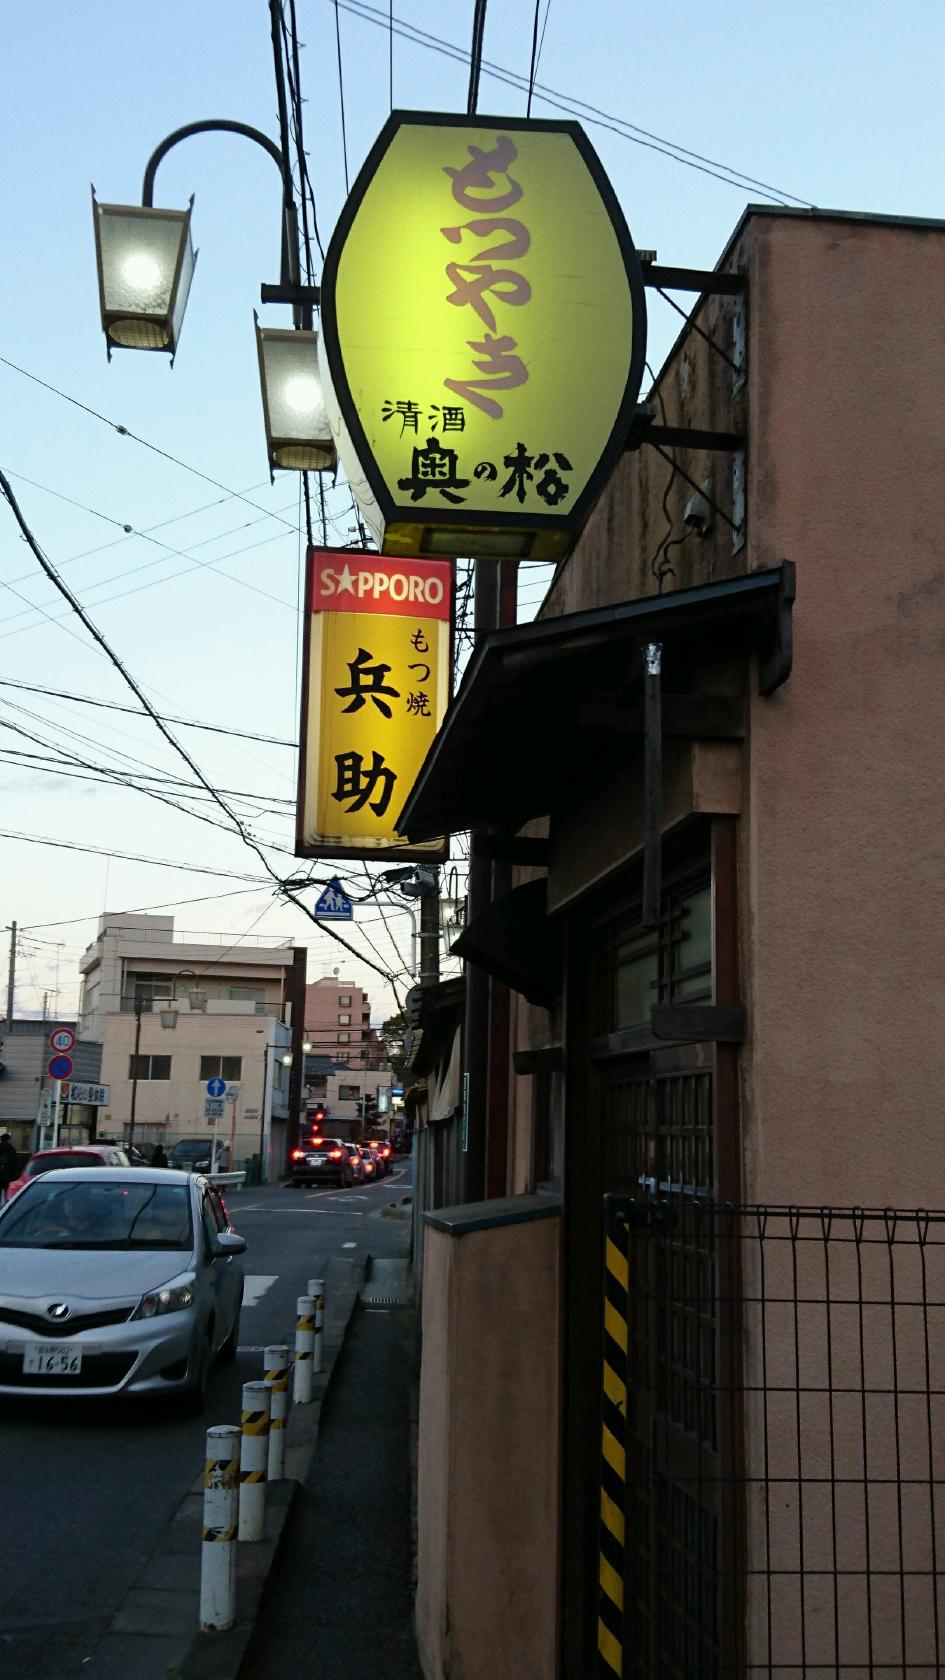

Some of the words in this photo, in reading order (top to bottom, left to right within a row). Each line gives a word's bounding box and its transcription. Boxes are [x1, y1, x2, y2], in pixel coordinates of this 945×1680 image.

[440, 134, 532, 420] もつやき
[381, 400, 465, 438] 清酒
[397, 437, 573, 505] 奥の松
[320, 564, 444, 605] SAPPORO
[406, 628, 432, 718] もつ焼
[331, 647, 401, 818] 兵助
[56, 1035, 70, 1046] 40
